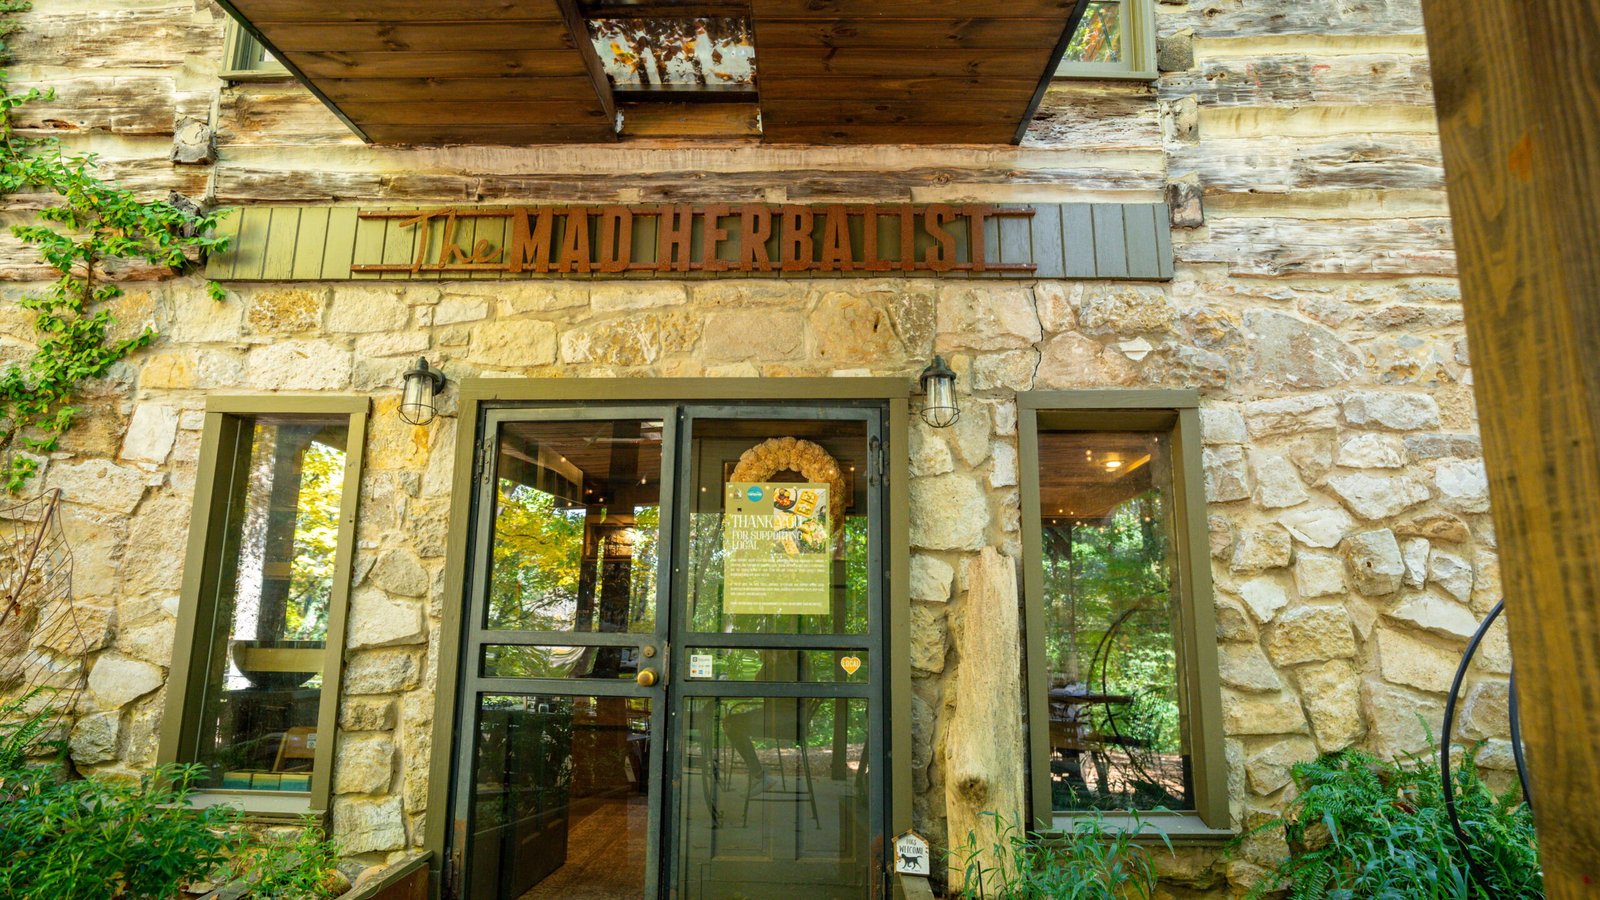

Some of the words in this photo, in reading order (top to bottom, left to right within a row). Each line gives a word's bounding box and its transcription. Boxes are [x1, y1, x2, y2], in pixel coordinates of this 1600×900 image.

[399, 207, 503, 273] The
[508, 207, 633, 272] MAD
[657, 205, 993, 272] HERBALIST
[732, 514, 773, 529] THANK
[732, 531, 750, 540] FOR
[731, 540, 759, 550] LOCAL
[899, 845, 923, 854] WELCOME
